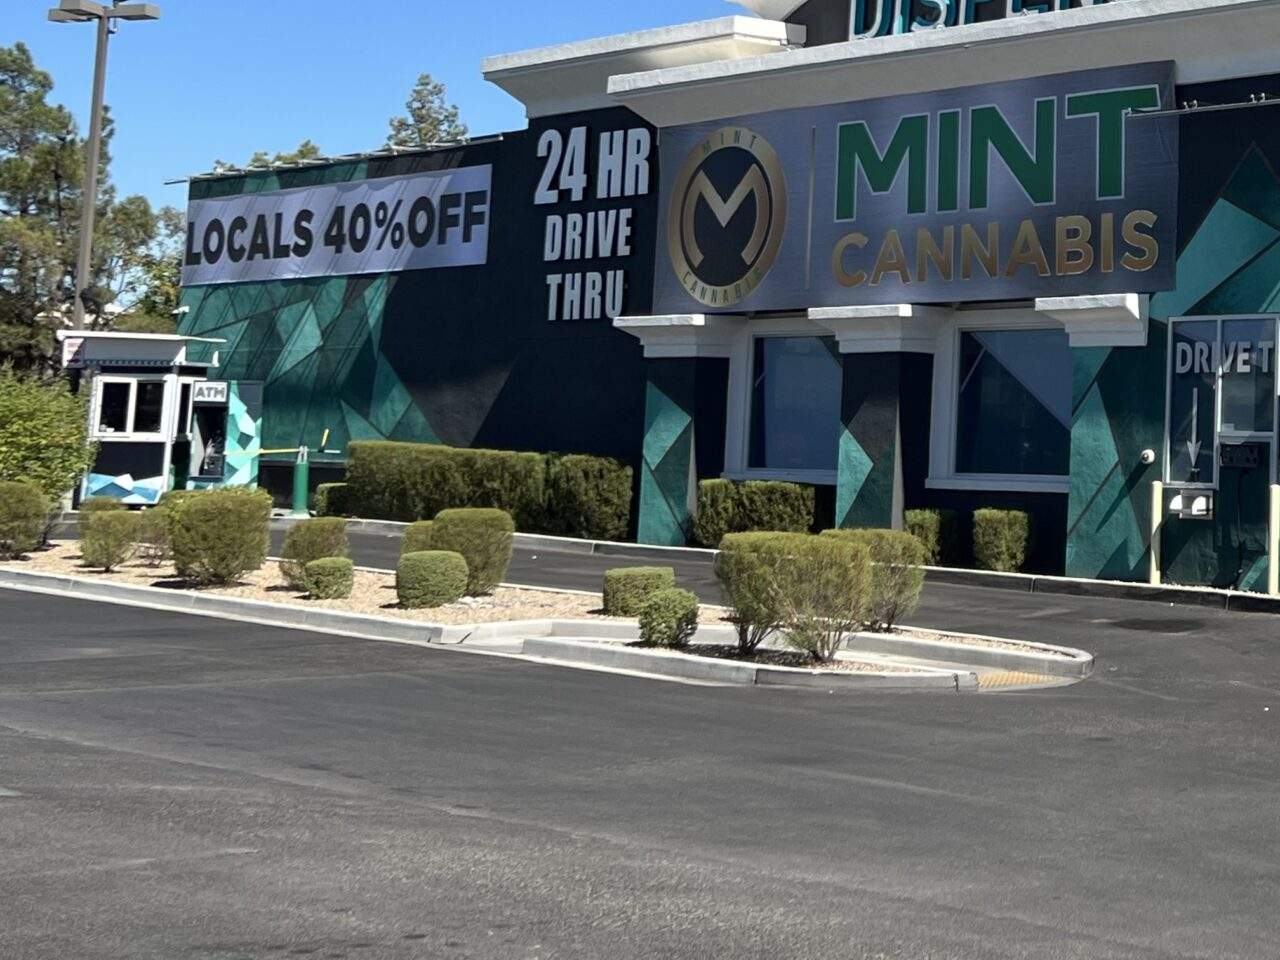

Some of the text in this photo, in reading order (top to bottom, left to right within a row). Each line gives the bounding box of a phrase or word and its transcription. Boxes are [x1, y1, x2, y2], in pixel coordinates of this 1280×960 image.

[534, 126, 651, 205] 24 HR
[701, 129, 758, 154] MINT
[832, 83, 1162, 222] MINT
[185, 208, 315, 267] LOCALS
[543, 207, 633, 262] DRIVE
[831, 209, 1159, 288] CANNABIS
[546, 270, 625, 321] THRU
[1175, 340, 1251, 374] DRIVE
[195, 386, 226, 399] ATM
